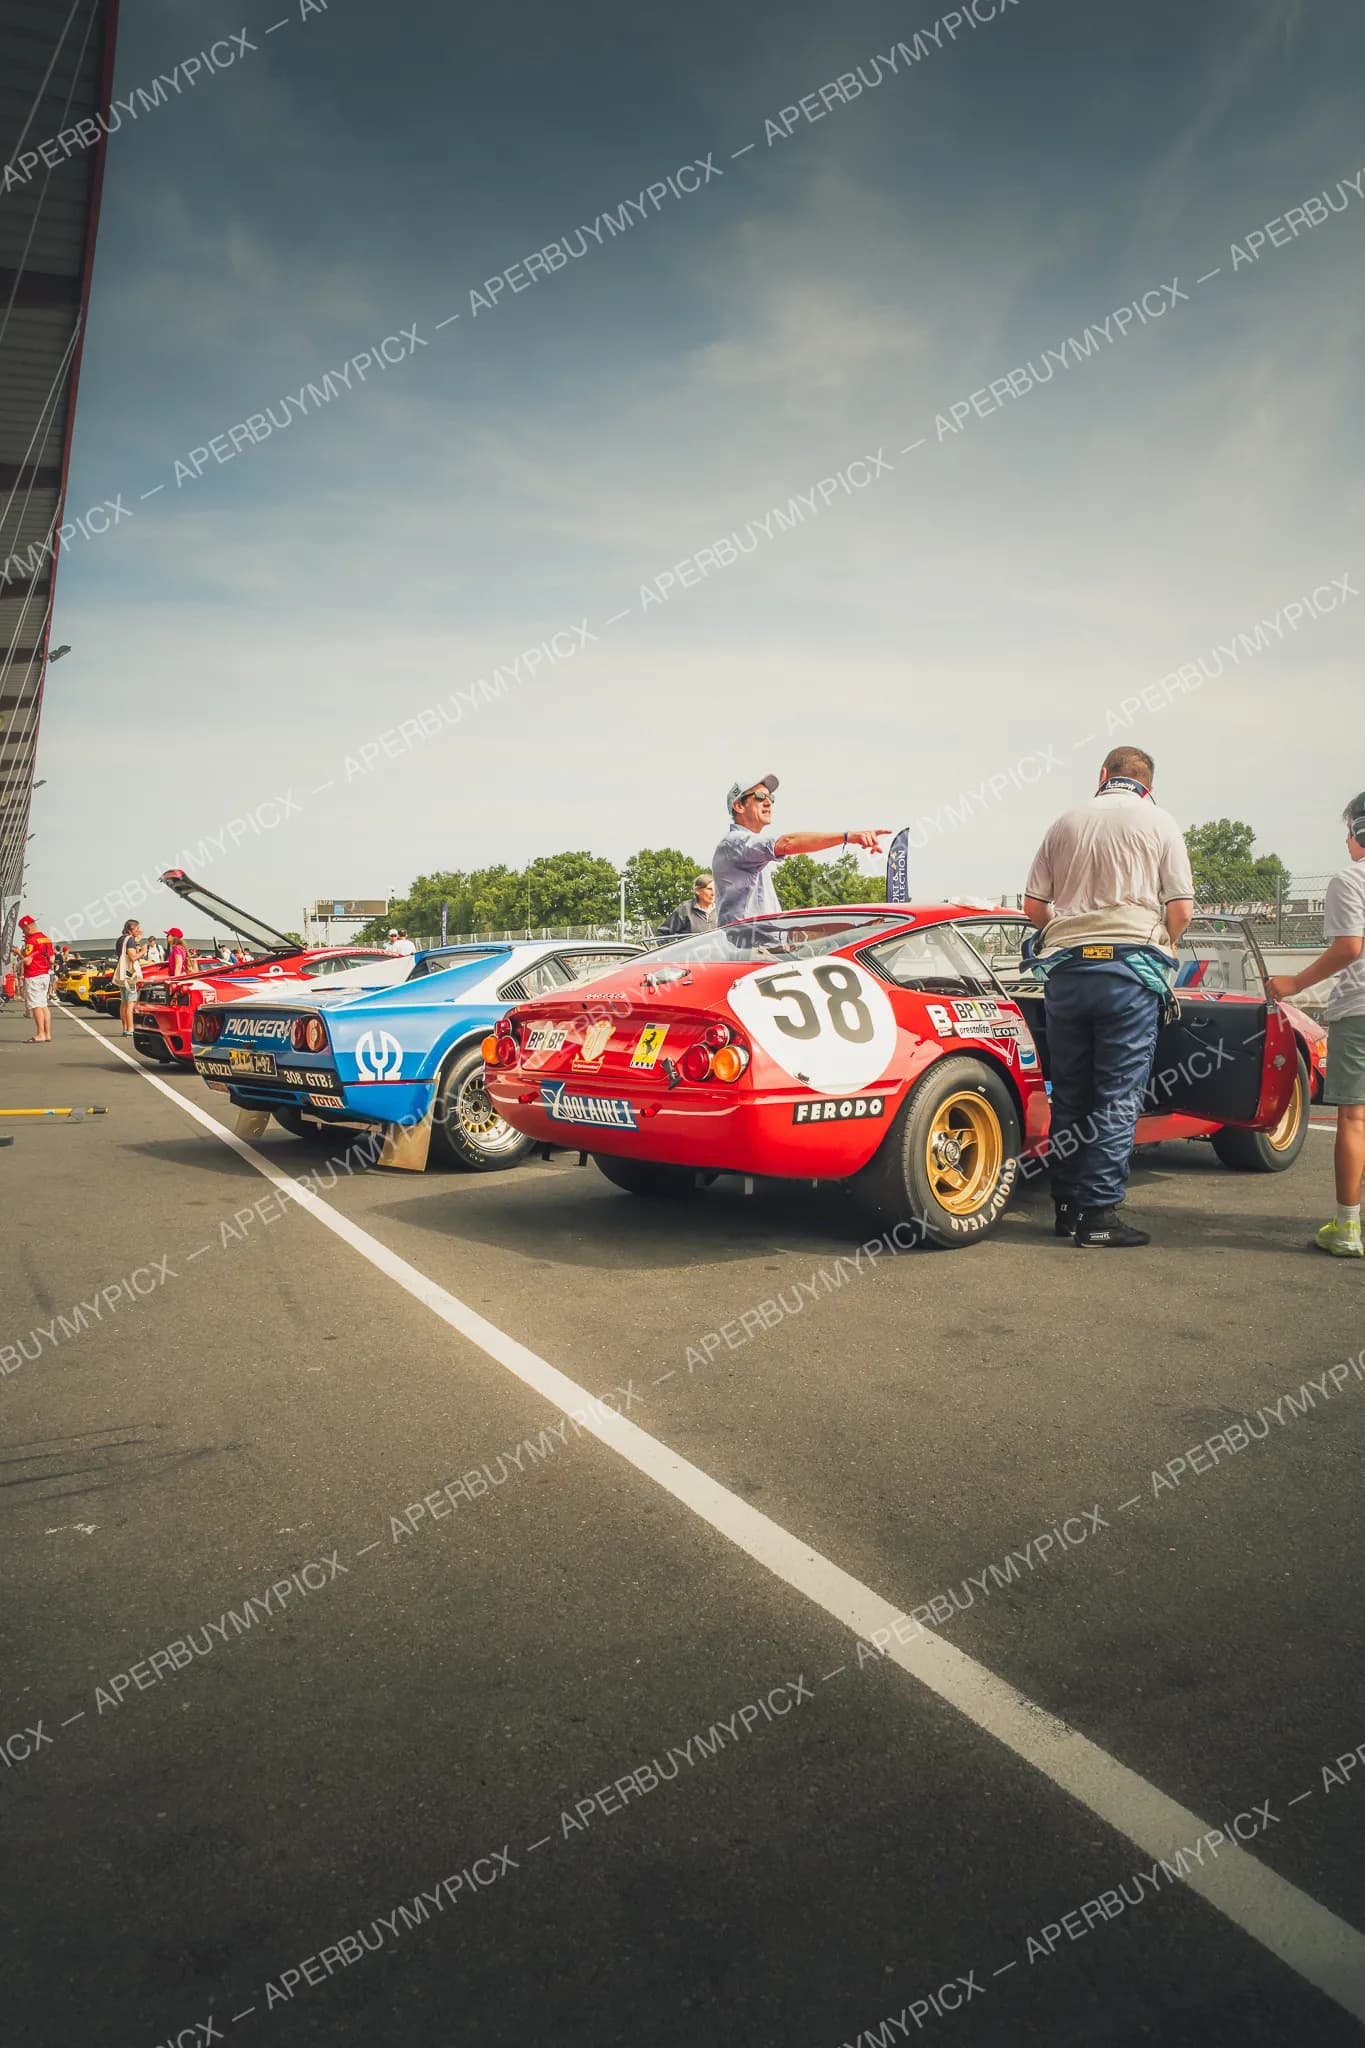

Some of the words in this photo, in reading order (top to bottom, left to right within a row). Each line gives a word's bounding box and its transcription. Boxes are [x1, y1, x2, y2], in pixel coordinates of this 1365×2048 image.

[755, 965, 874, 1043] 58
[955, 1003, 974, 1018] BP
[978, 1003, 998, 1018] BP
[225, 1018, 285, 1038] PIONEER
[959, 1024, 990, 1036] prestolite
[528, 1032, 545, 1048] BP
[548, 1032, 565, 1048] BP
[209, 1064, 233, 1077] POZZI
[283, 1070, 303, 1085] 308
[312, 1095, 343, 1108] TOTAL
[796, 1099, 882, 1121] FERODO
